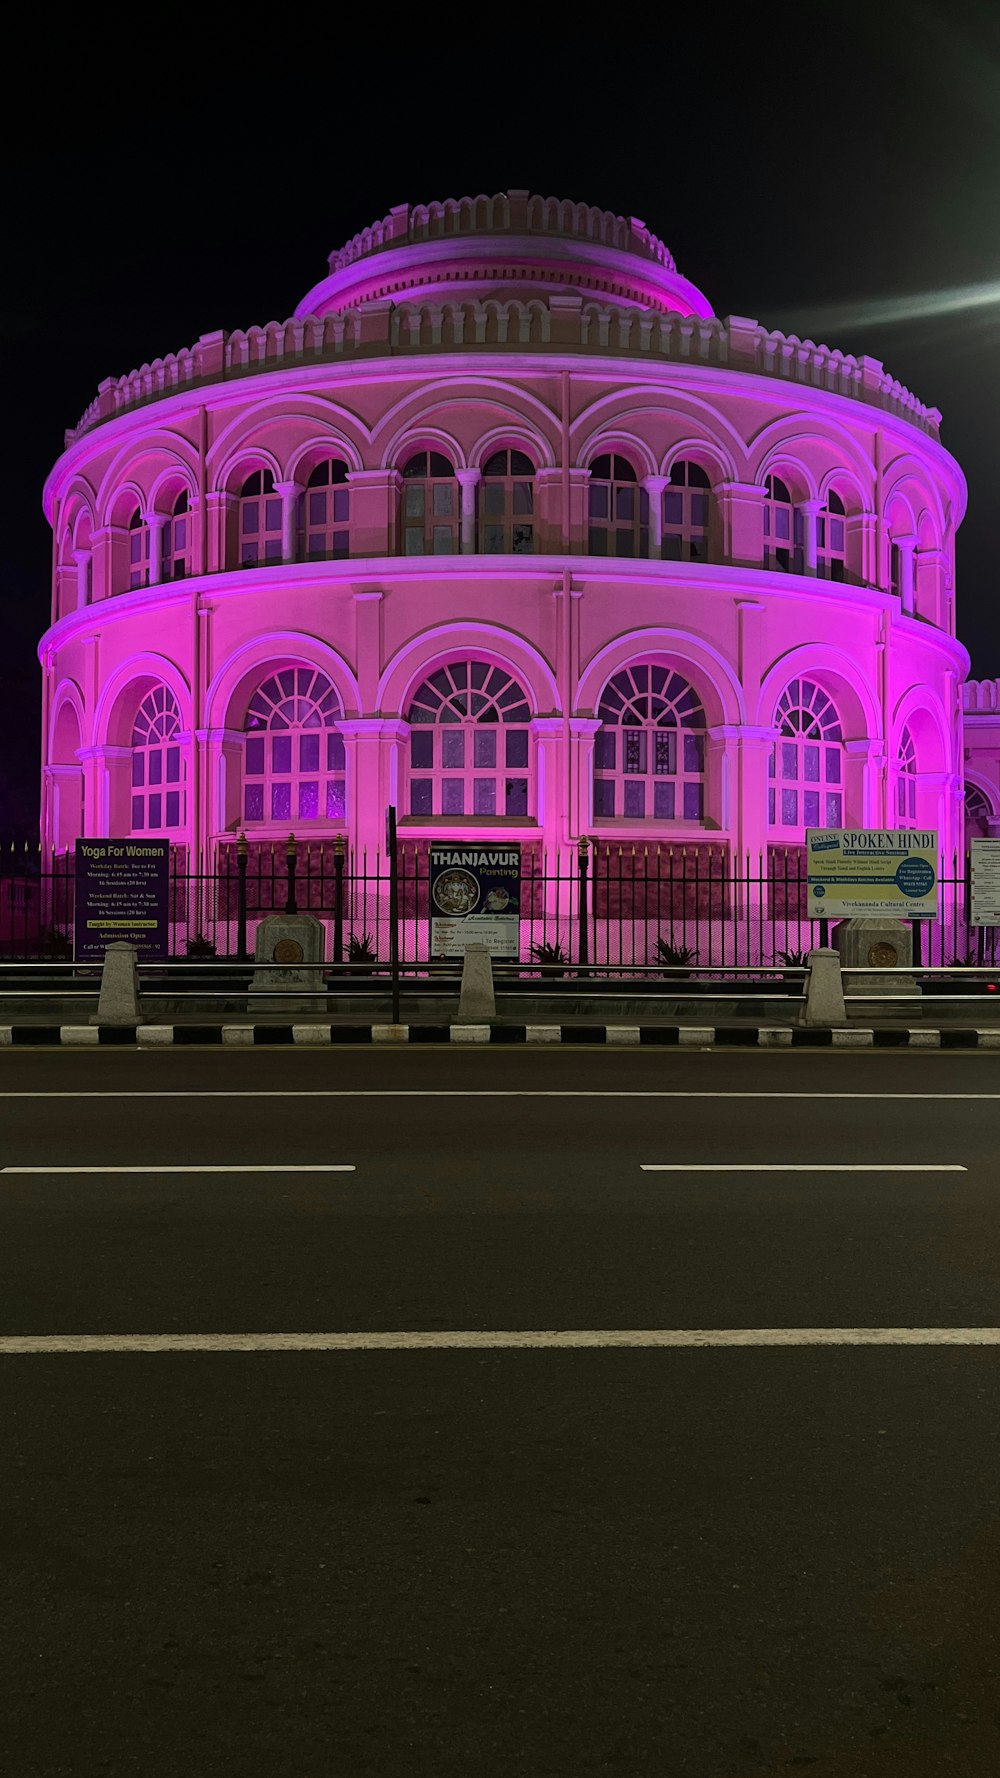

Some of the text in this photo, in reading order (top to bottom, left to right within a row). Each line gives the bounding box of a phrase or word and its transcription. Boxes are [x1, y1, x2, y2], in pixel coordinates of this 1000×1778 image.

[810, 834, 838, 843] ONLINE
[843, 833, 934, 849] SPOKEN HINDI
[81, 846, 164, 859] Yoga For Women
[431, 852, 519, 867] THANJAVUR
[480, 867, 519, 879] Painting
